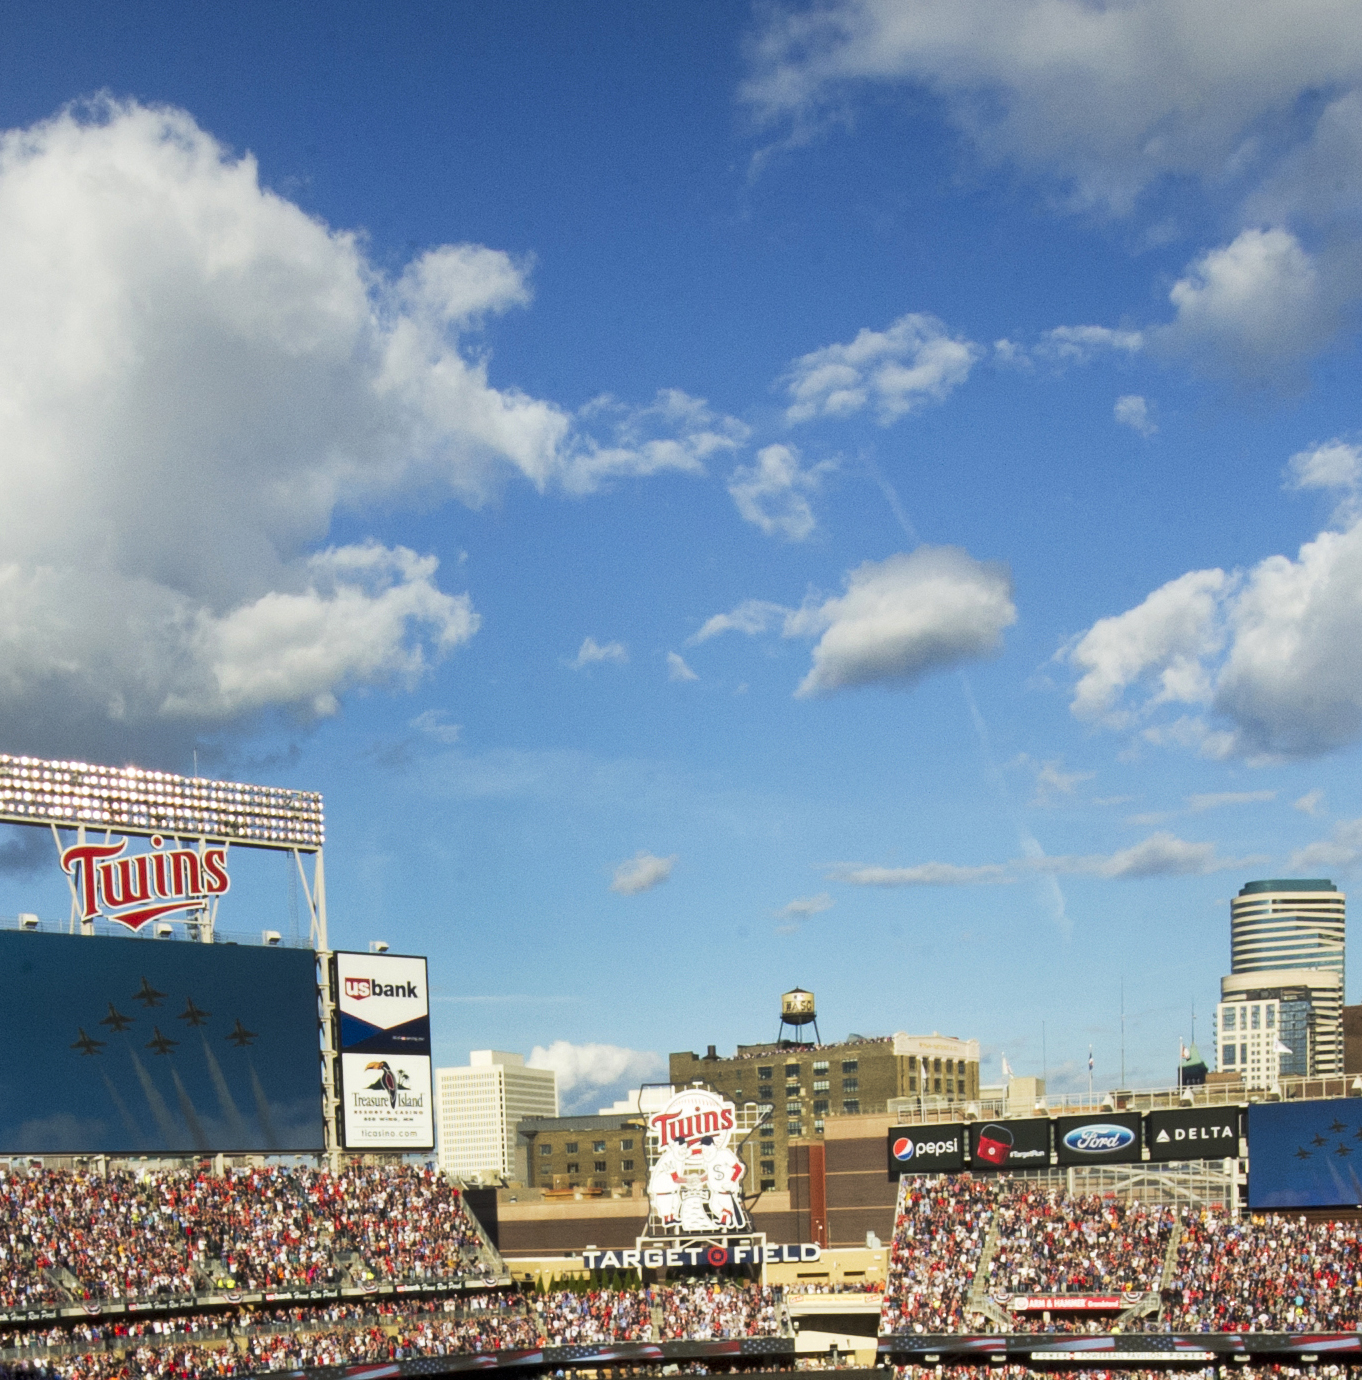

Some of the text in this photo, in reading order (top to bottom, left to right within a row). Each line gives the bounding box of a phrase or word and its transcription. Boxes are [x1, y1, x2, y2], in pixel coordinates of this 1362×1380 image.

[60, 835, 231, 922] Twins
[352, 1092, 424, 1108] Treasure Island
[361, 1130, 418, 1138] ticasino.com
[651, 1107, 734, 1148] Twins
[1175, 1126, 1233, 1141] DELTA
[915, 1138, 958, 1157] pepsi
[1077, 1131, 1120, 1149] Ford
[1009, 1149, 1045, 1159] #TargetRun
[712, 1164, 725, 1181] S
[582, 1244, 821, 1269] TARGET FIELD
